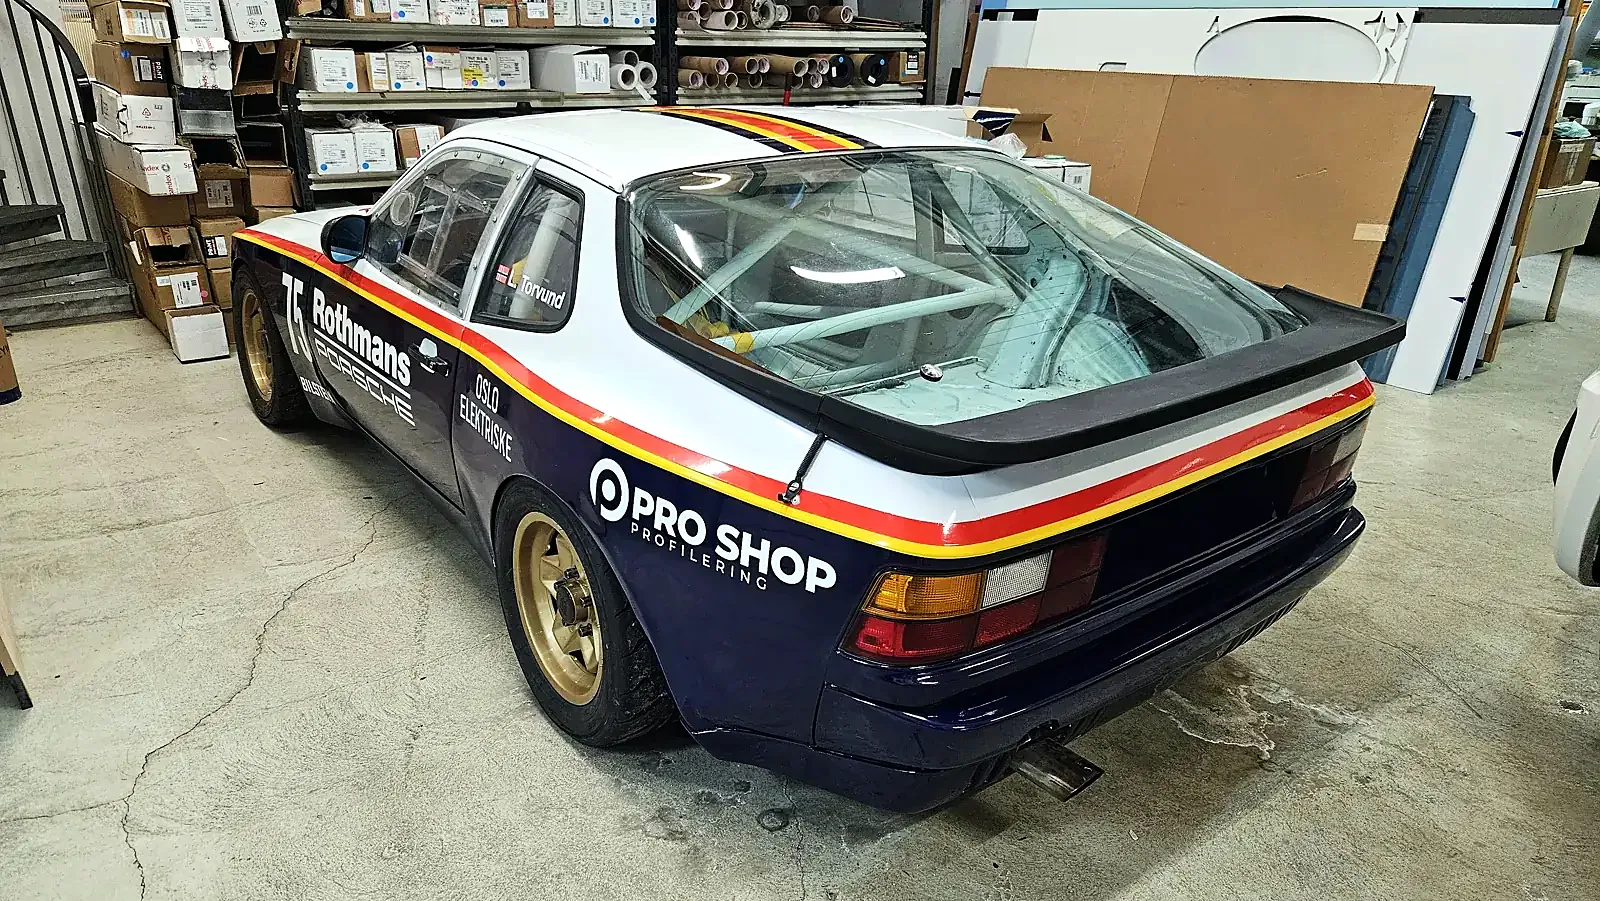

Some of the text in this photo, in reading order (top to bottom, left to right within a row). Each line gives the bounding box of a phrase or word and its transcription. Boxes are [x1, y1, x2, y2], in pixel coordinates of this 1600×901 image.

[281, 271, 313, 364] 75
[520, 273, 567, 310] Torvund
[312, 287, 411, 387] Rothmans
[314, 337, 416, 427] PORSCHE
[474, 372, 500, 413] OSLO
[459, 393, 513, 463] ELEKTRISKE
[630, 521, 768, 591] PROFILERING
[631, 486, 838, 594] PRO SHOP
